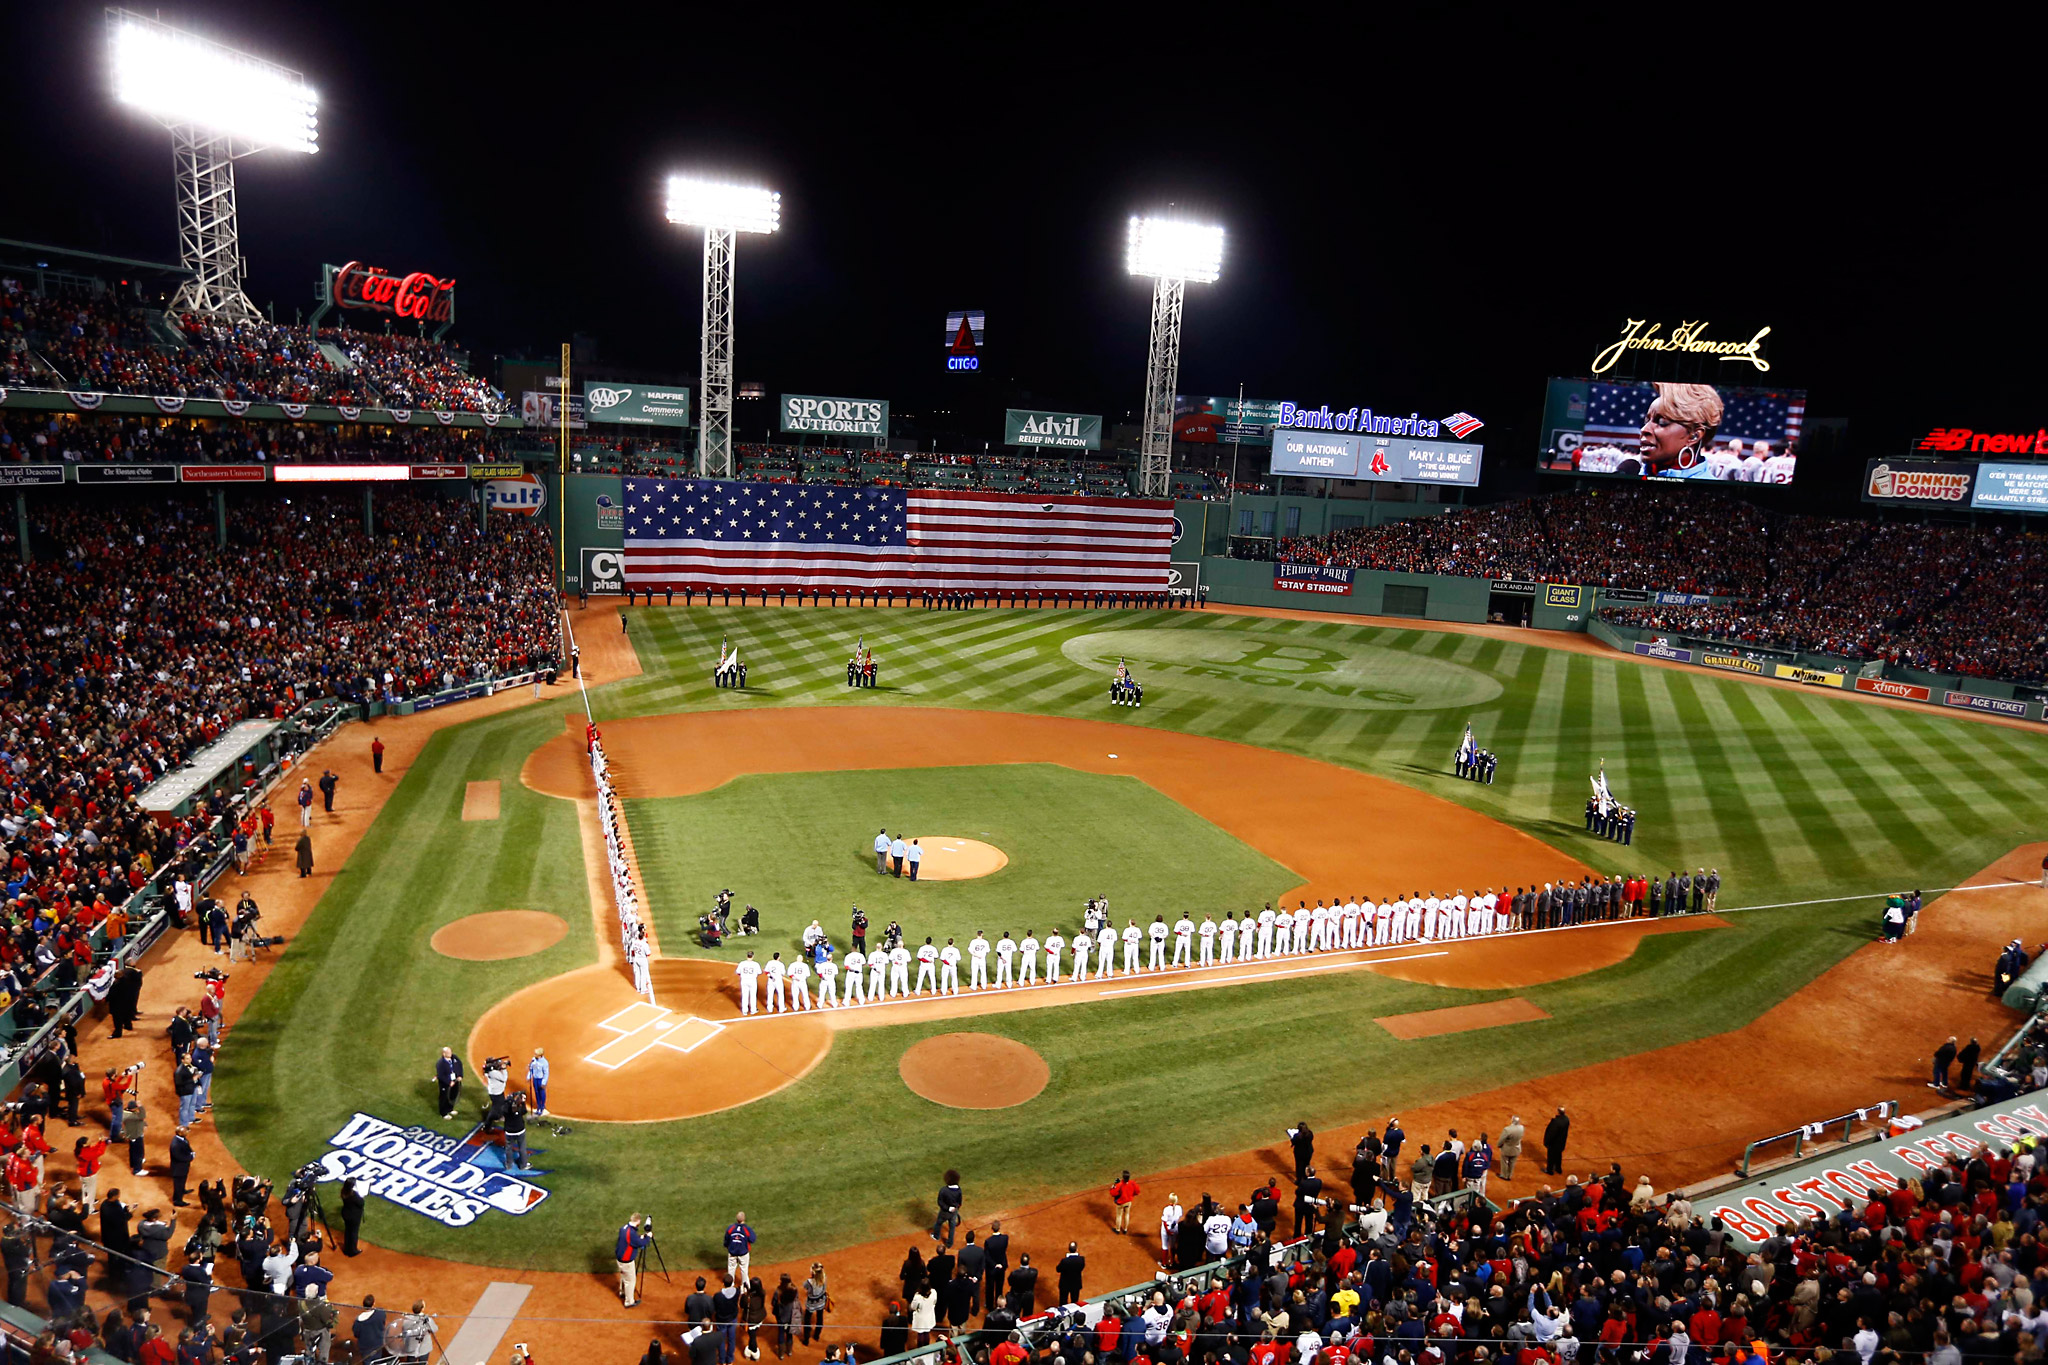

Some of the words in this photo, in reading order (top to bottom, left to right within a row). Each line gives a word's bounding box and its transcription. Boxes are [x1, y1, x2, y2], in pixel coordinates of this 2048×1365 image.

[334, 261, 456, 321] Coca-Cola
[1592, 318, 1662, 373] John
[1663, 320, 1771, 372] Hancock
[948, 357, 978, 370] CITGO
[590, 388, 617, 407] AAA
[647, 392, 684, 401] MAPFRE
[642, 405, 684, 414] Commerce
[788, 398, 881, 421] SPORTS
[788, 418, 881, 433] AUTHORITY
[1020, 414, 1079, 436] Advil
[1279, 402, 1334, 430] Bank
[1335, 407, 1358, 431] of
[1357, 409, 1439, 437] America
[1019, 435, 1043, 444] RELIEF
[1045, 436, 1054, 444] IN
[1056, 437, 1086, 446] ACTION
[1971, 434, 2036, 453] new
[1287, 443, 1304, 453] OUR
[1306, 444, 1348, 456] NATIONAL
[1299, 456, 1334, 467] ANTHEM
[1408, 450, 1434, 461] MARY
[1437, 453, 1444, 462] J.
[1447, 454, 1472, 464] BLIGE
[5, 468, 24, 476] Israel
[25, 468, 60, 476] Deaconess
[186, 469, 229, 478] Northeastern
[230, 469, 262, 478] University
[1898, 473, 1968, 487] DUNKIN'
[1896, 485, 1961, 499] DONUTS
[1978, 494, 2025, 502] GALLANTLY
[1280, 564, 1319, 577] FENWAY
[1322, 568, 1349, 582] PARK
[1277, 580, 1304, 590] "STAY
[1306, 583, 1348, 593] STRONG"
[1551, 588, 1575, 596] GIANT
[1550, 595, 1575, 604] GLASS
[1662, 594, 1686, 603] NESN
[1647, 647, 1676, 658] jetBlue
[1704, 655, 1741, 666] GRANITE
[1742, 661, 1761, 673] CITY
[1792, 670, 1825, 682] Nikon
[1872, 682, 1912, 696] xfinity
[1971, 698, 1989, 708] ACE
[1992, 700, 2024, 713] TICKET
[401, 1126, 458, 1152] 2013
[329, 1113, 486, 1191] WORLD
[317, 1149, 490, 1227] SERIES
[1710, 1159, 1900, 1244] BOSTON
[1213, 1223, 1228, 1234] 23
[1155, 1321, 1169, 1331] 38
